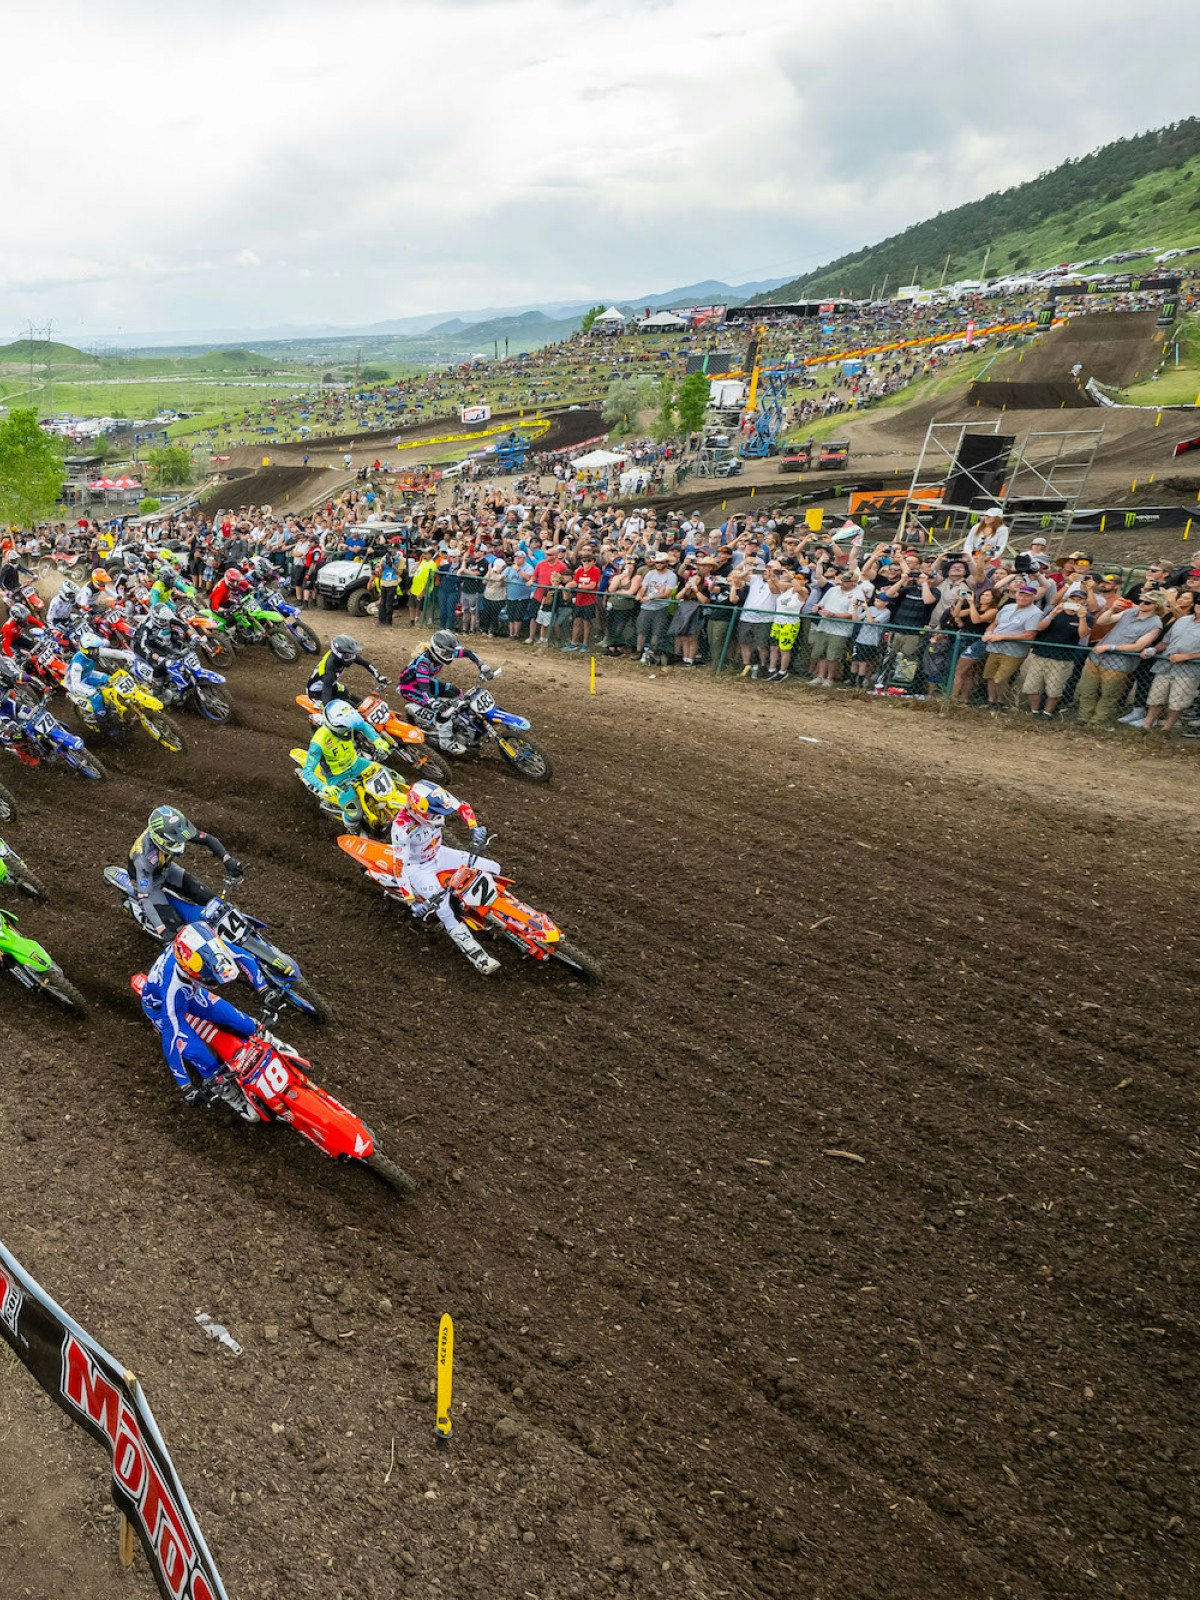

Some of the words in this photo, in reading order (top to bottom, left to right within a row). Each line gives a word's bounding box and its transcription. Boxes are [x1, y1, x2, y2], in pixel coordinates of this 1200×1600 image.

[119, 679, 136, 694] 50
[476, 693, 495, 712] 483
[37, 713, 56, 733] 78
[415, 707, 435, 721] 483
[472, 876, 497, 907] 2
[217, 910, 247, 941] 14
[256, 1057, 289, 1099] 18
